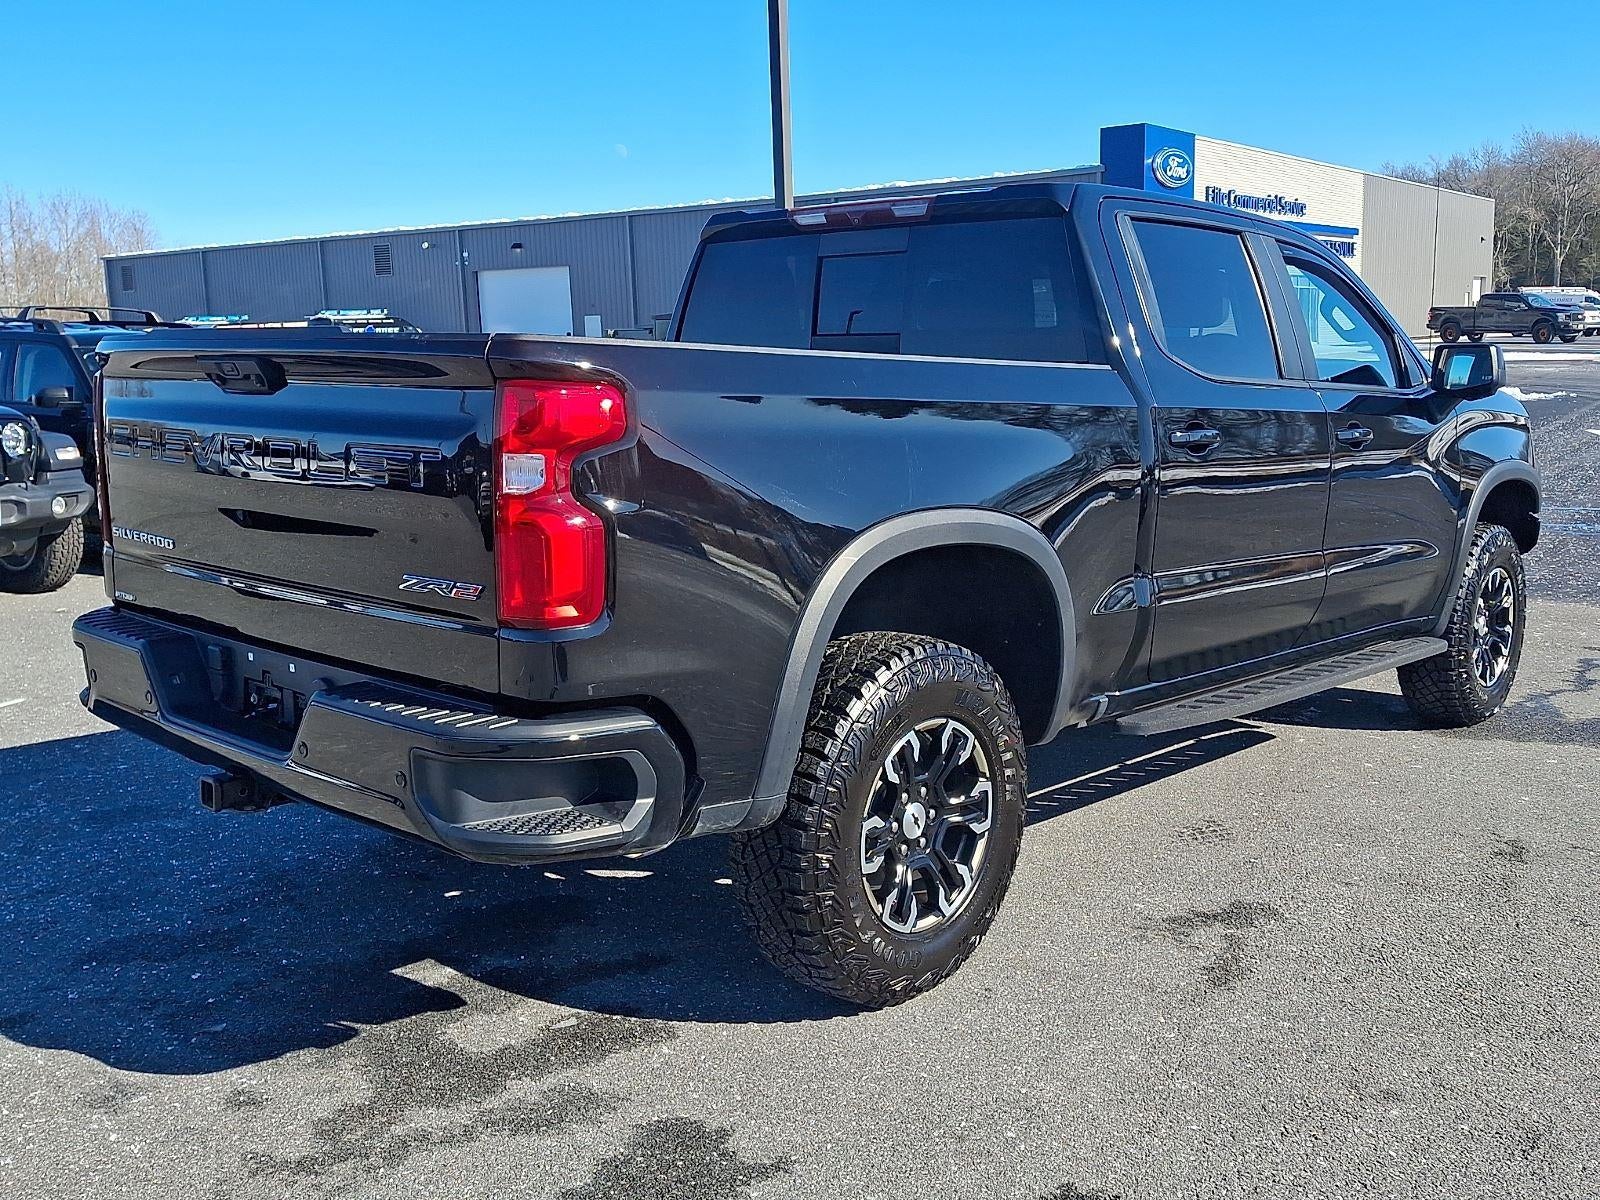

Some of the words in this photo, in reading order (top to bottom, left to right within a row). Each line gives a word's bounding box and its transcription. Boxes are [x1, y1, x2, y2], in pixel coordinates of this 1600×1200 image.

[1166, 155, 1188, 179] Ford
[1205, 186, 1228, 205] Elite
[1228, 189, 1278, 214] Commercial
[1278, 196, 1307, 217] Service
[110, 423, 442, 488] CHEVROLET
[112, 526, 176, 550] SILVERADO
[398, 574, 484, 601] ZR2
